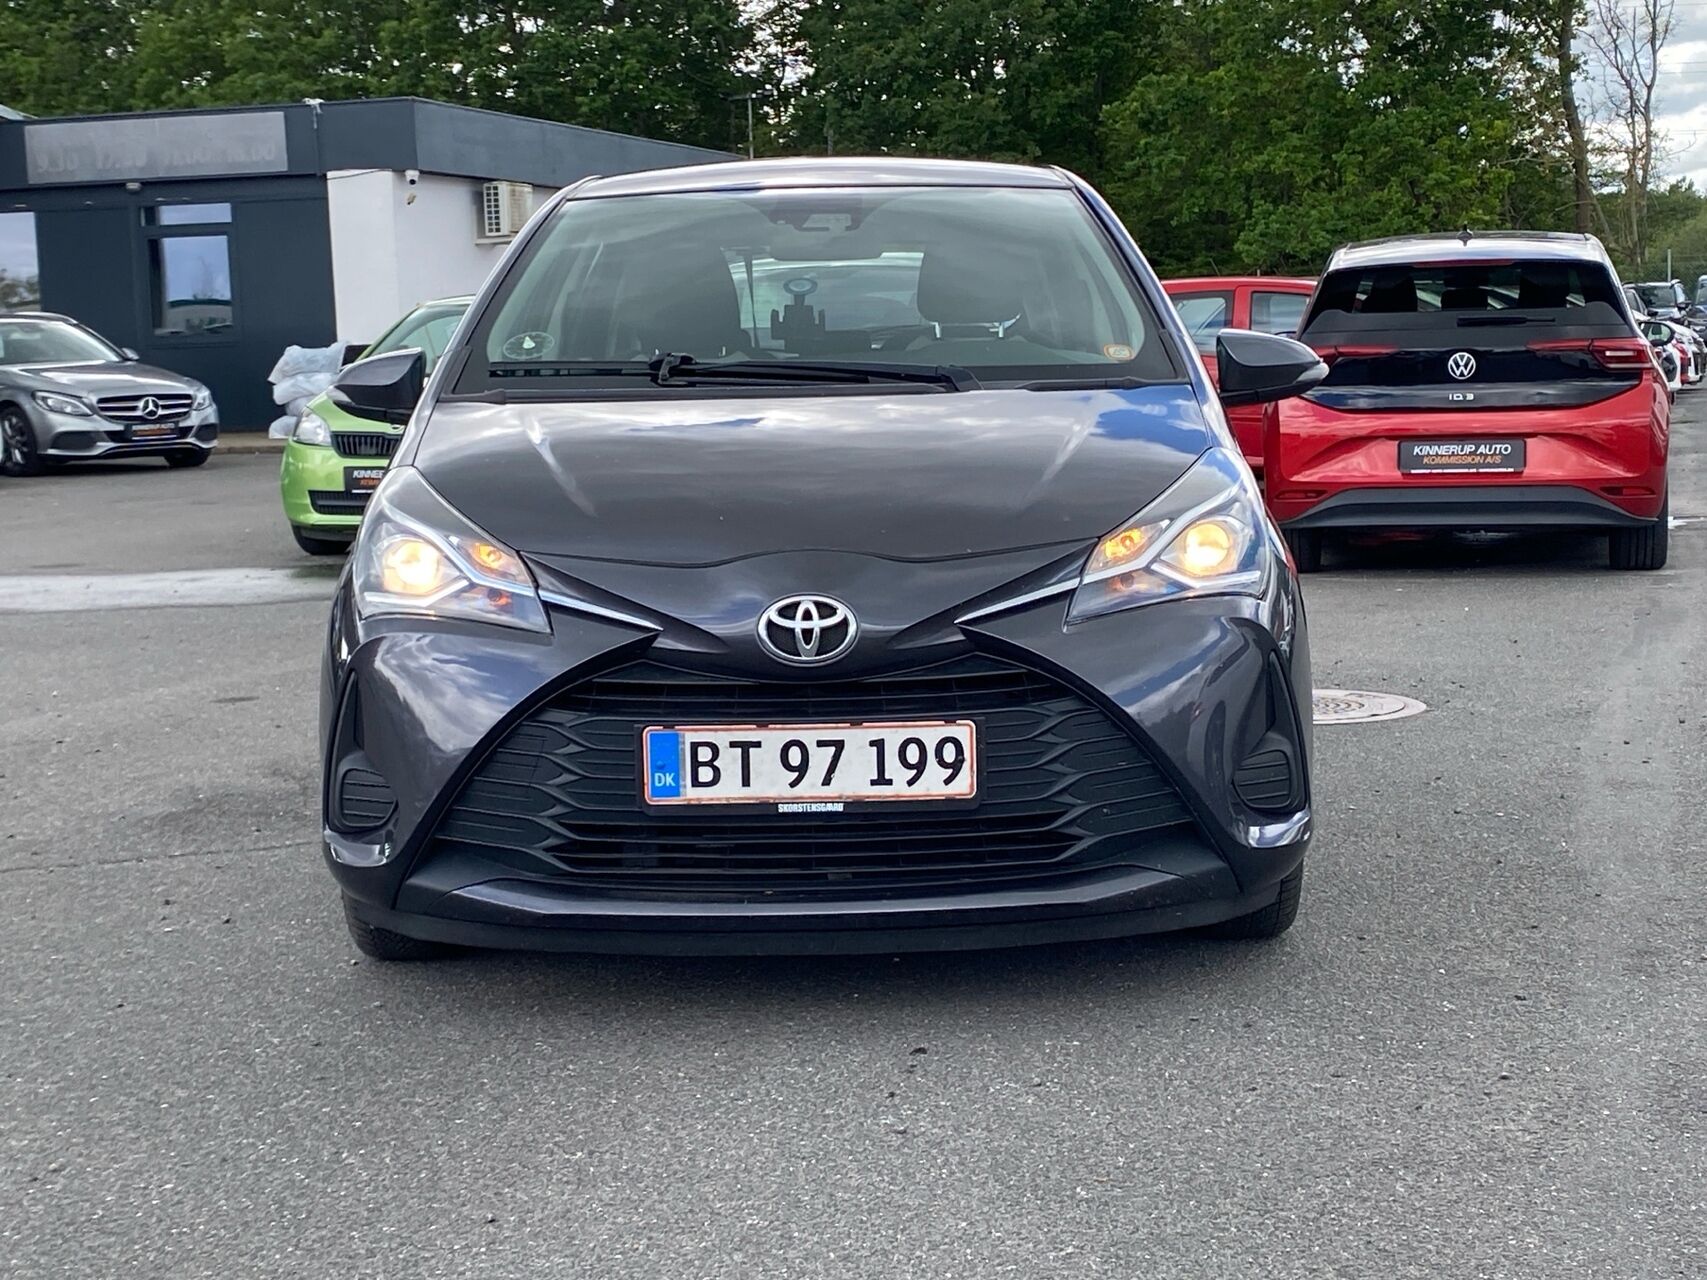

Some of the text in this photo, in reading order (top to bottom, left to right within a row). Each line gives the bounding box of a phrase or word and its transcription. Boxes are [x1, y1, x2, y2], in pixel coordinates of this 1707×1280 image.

[1413, 444, 1512, 456] KINNERUP AUTO
[1423, 455, 1502, 465] KOMMISSION A/S
[690, 736, 966, 789] BT 97 199
[654, 772, 676, 787] DK
